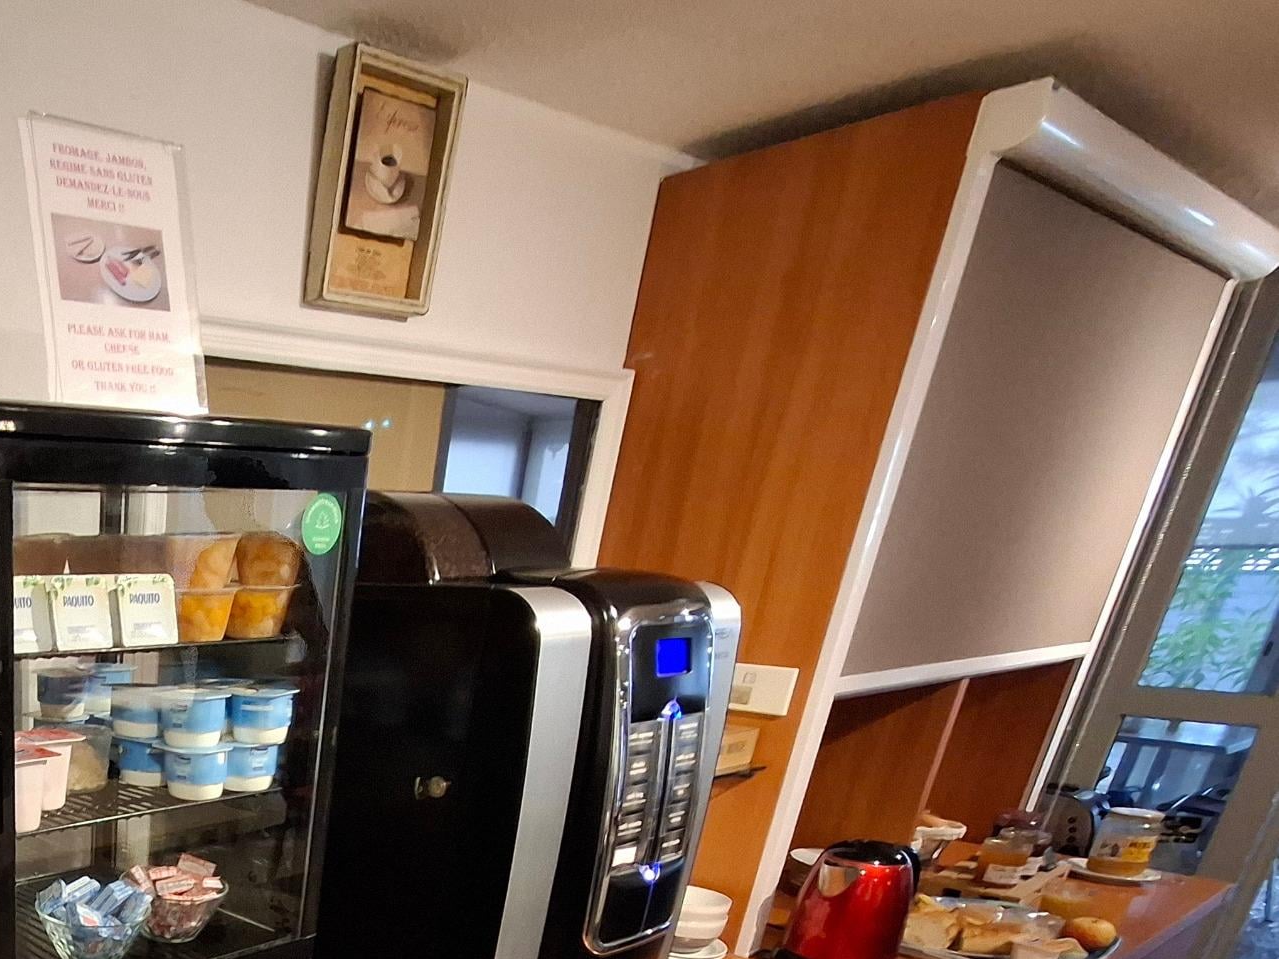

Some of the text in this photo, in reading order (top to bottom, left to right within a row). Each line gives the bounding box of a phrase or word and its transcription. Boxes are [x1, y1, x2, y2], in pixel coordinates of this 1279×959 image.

[86, 196, 116, 212] MERCI
[67, 323, 105, 337] PLEASE
[107, 327, 127, 339] ASK
[128, 329, 146, 341] FOR
[71, 360, 84, 371] OR
[87, 361, 124, 374] GLUTEN
[151, 365, 174, 377] FOOD
[94, 381, 127, 393] THANK
[128, 382, 148, 393] YOU
[14, 596, 32, 609] UITO
[63, 594, 95, 608] PAQUITO
[129, 592, 160, 605] PAQUITO
